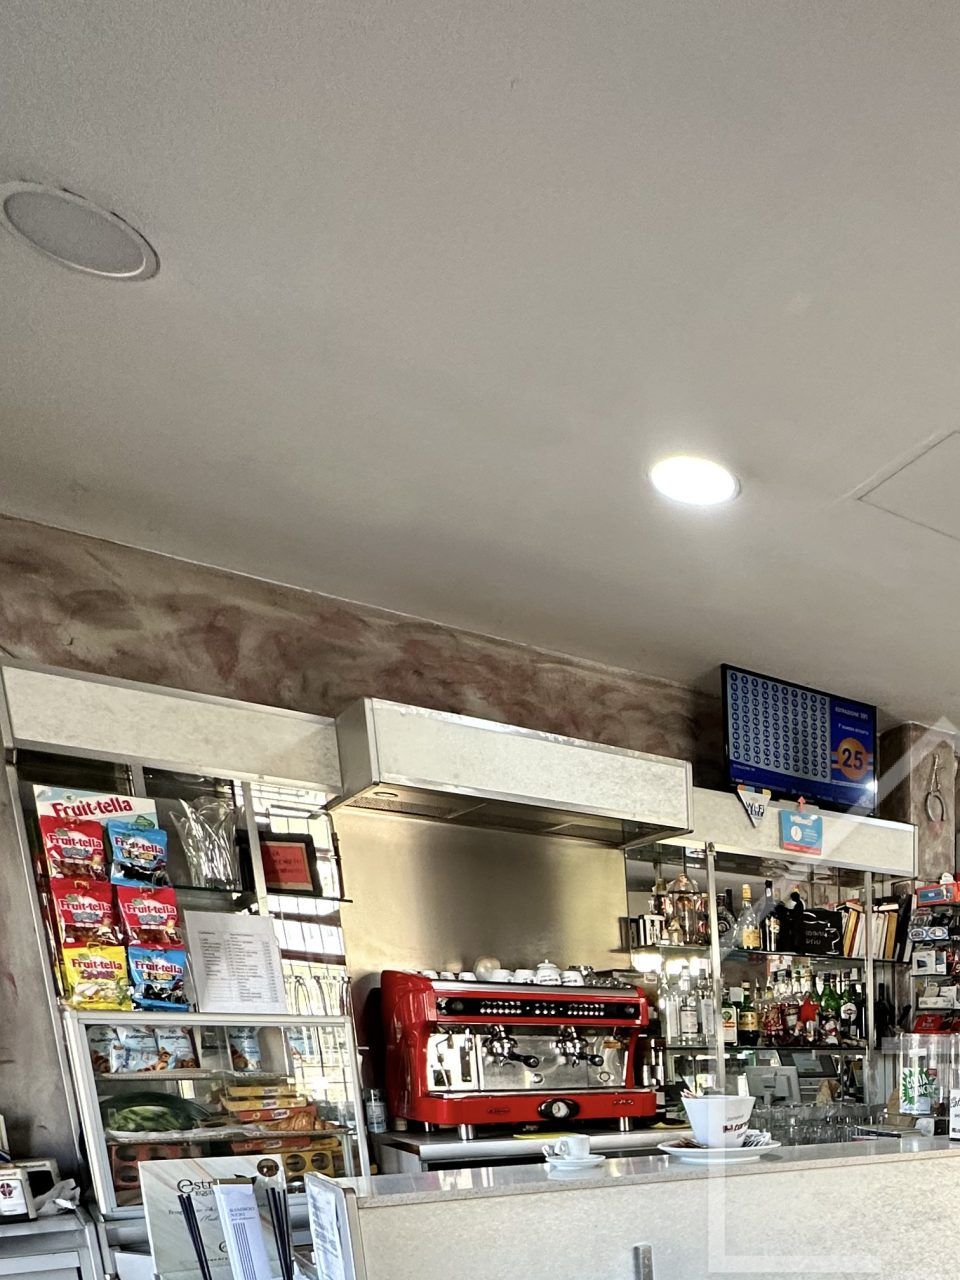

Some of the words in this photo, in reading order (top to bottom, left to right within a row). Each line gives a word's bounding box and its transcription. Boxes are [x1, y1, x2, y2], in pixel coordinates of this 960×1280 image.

[841, 747, 864, 771] 25
[51, 796, 133, 818] Fruit-tella
[49, 834, 103, 849] Fruit-tella
[60, 900, 113, 913] Fruit-tella
[125, 903, 178, 915] Fruit-tella
[71, 958, 123, 971] Fruit-tella
[134, 960, 184, 975] Fruit-tella
[176, 1179, 213, 1194] estr
